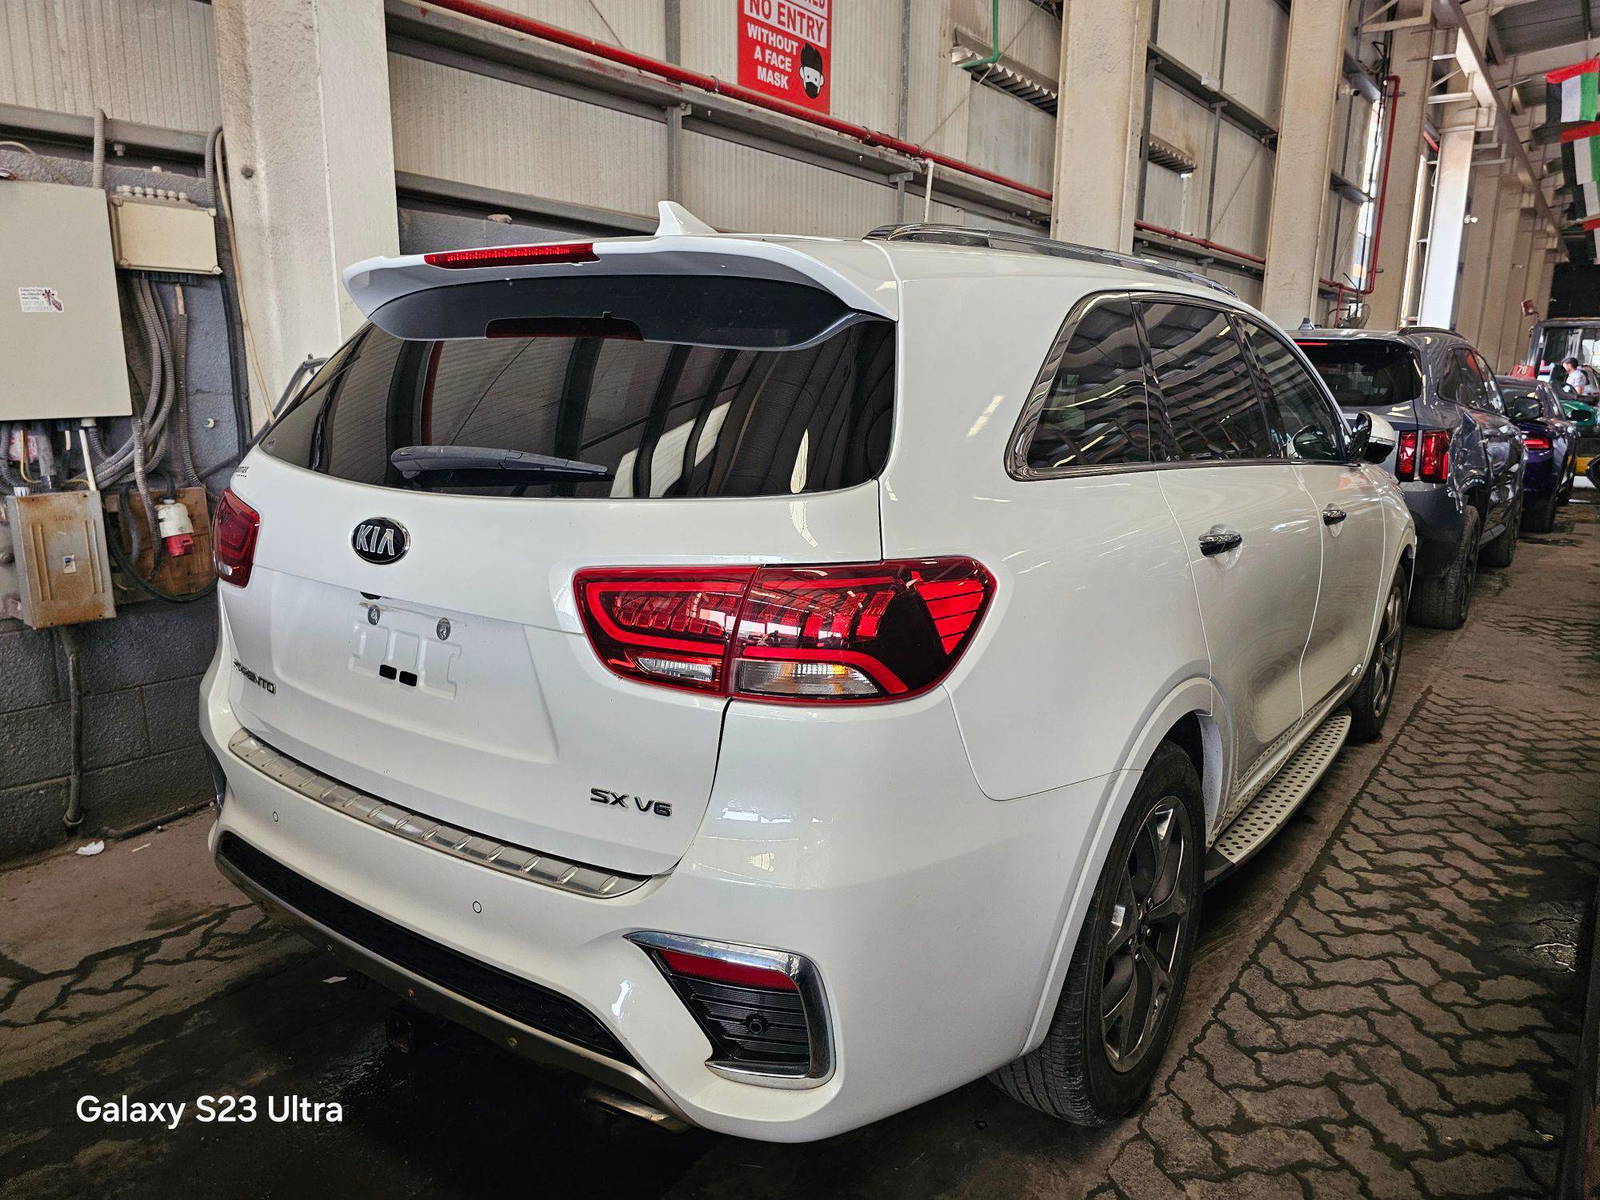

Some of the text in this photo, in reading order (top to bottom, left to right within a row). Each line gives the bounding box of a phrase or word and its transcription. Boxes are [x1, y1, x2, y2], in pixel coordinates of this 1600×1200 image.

[750, 0, 824, 42] NO ENTRY
[747, 22, 798, 56] WITHOUT
[754, 45, 792, 72] A FACE
[757, 65, 788, 90] MASK
[356, 524, 395, 556] KIA
[590, 787, 672, 817] SX V6
